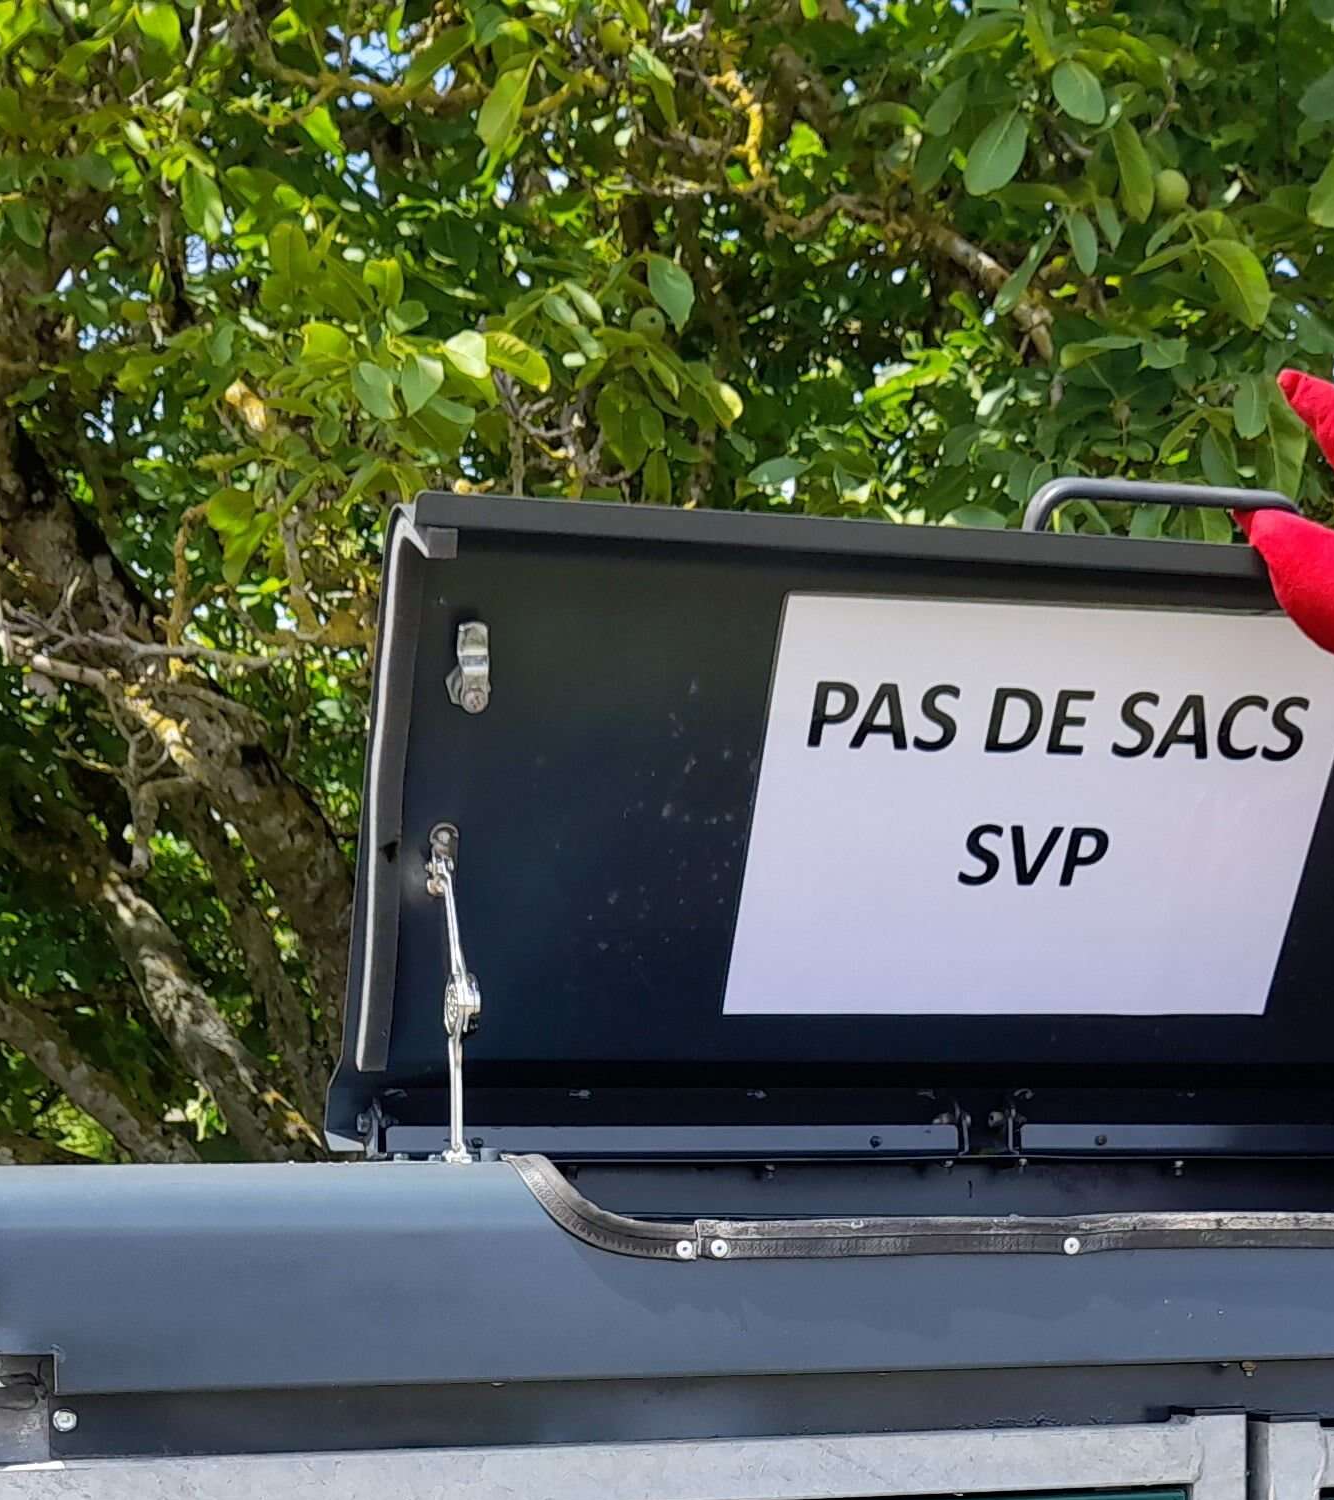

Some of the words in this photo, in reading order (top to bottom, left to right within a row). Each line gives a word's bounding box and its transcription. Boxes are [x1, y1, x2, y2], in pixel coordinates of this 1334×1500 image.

[807, 681, 961, 752] PAS
[984, 687, 1095, 756] DE
[1111, 691, 1310, 762] SACS
[957, 823, 1109, 887] SVP
